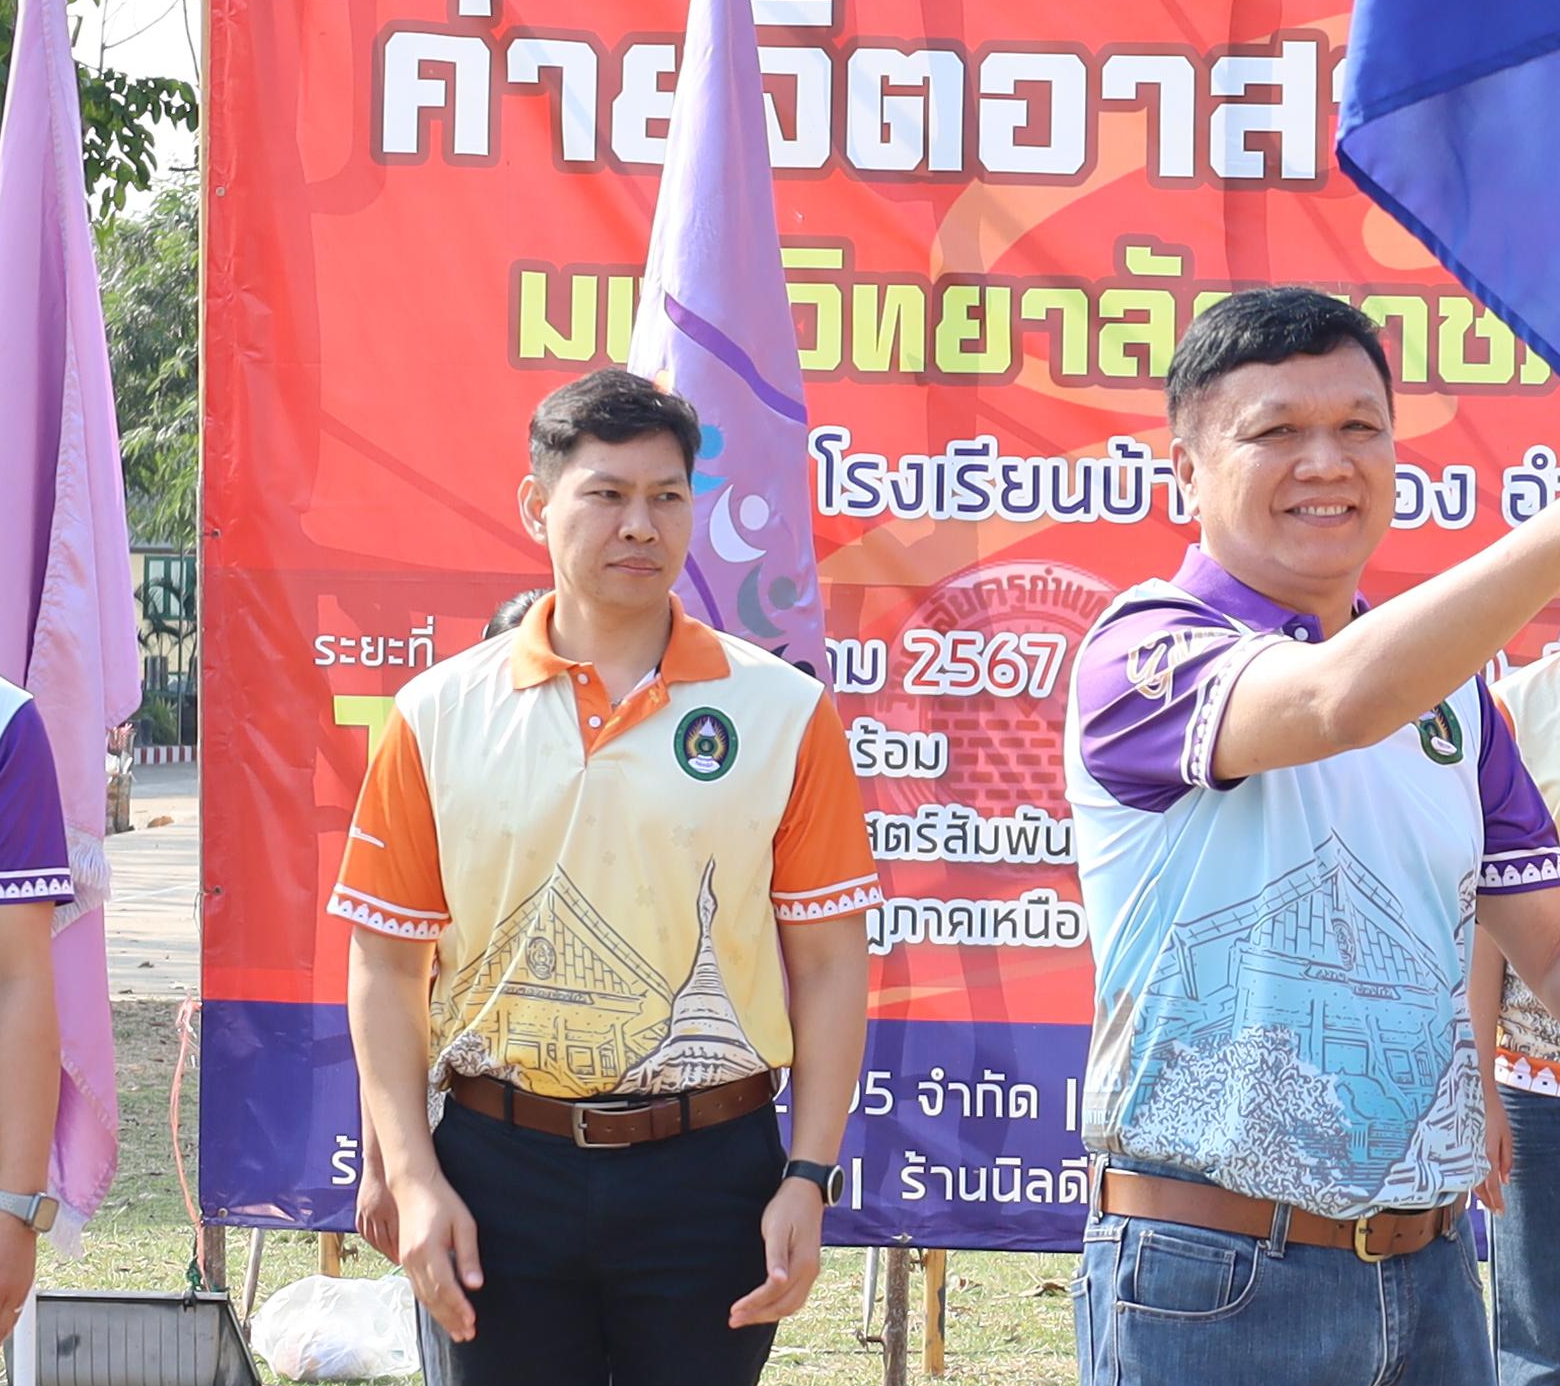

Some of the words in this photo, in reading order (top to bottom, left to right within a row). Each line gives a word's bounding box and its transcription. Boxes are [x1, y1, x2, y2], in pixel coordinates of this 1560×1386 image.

[313, 614, 435, 668] ระยะที่
[910, 634, 1063, 692] 2567
[917, 1067, 1039, 1120] จำกัด
